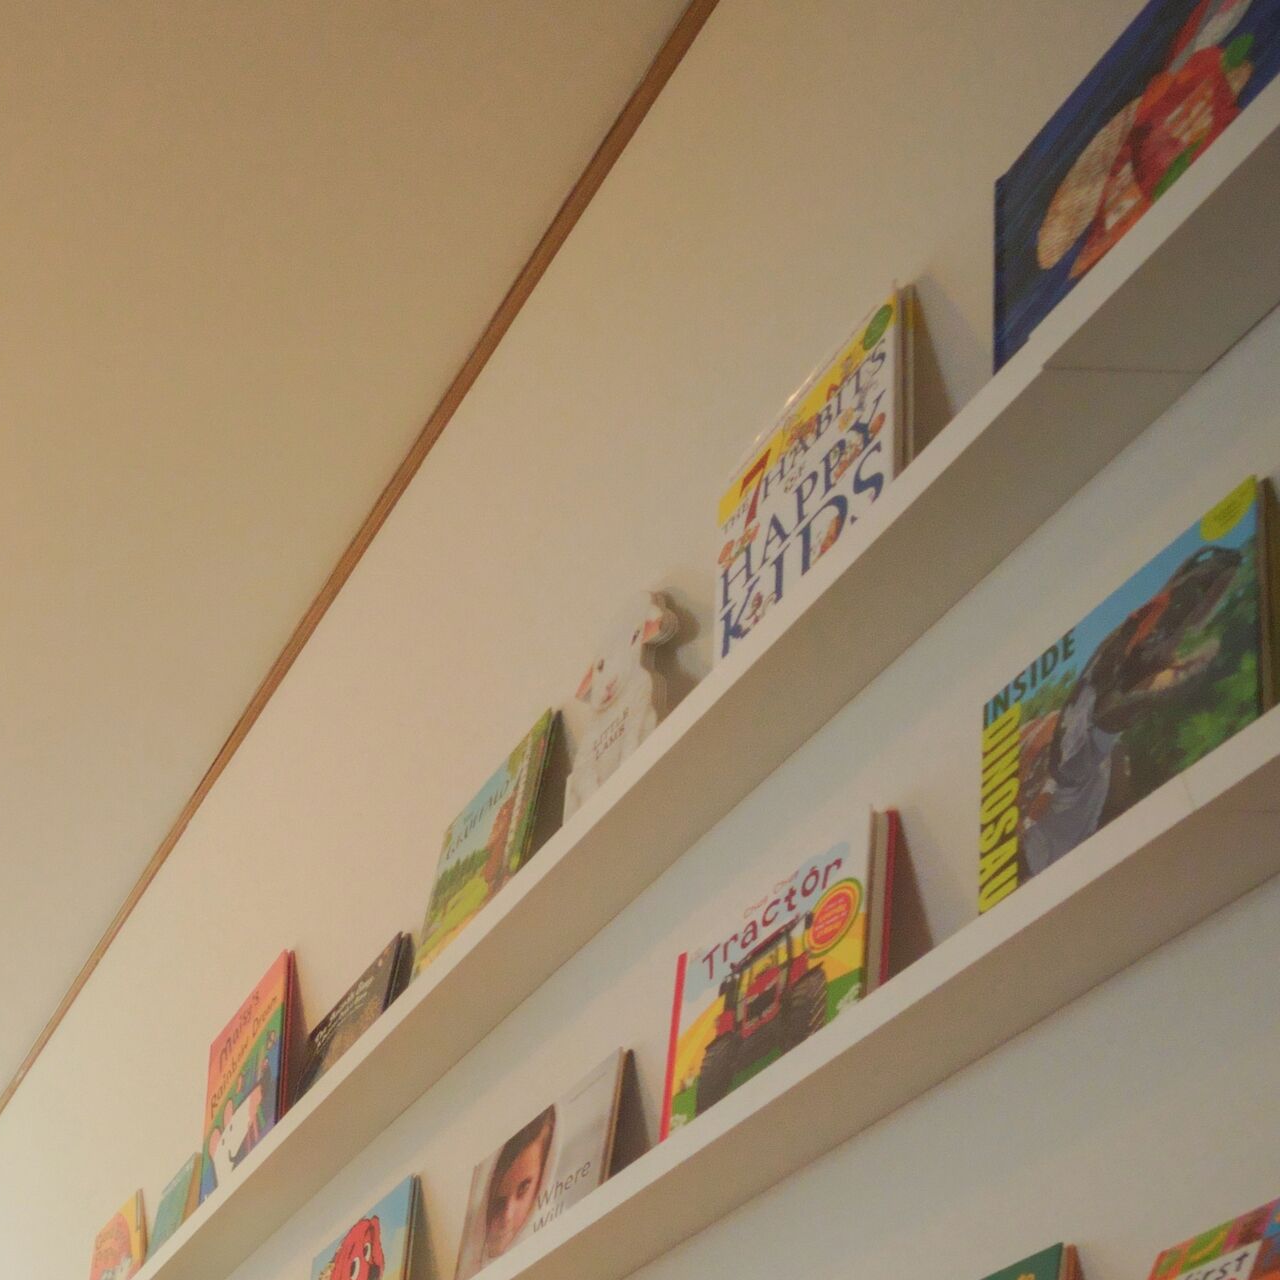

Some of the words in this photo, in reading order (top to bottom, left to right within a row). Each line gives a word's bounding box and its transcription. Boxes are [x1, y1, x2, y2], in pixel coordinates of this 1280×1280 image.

[739, 448, 771, 527] 7
[763, 338, 886, 502] HABITS
[721, 388, 887, 610] HAPPY
[983, 628, 1075, 727] INSIDE
[702, 857, 842, 980] Tractor
[537, 1161, 591, 1210] Where
